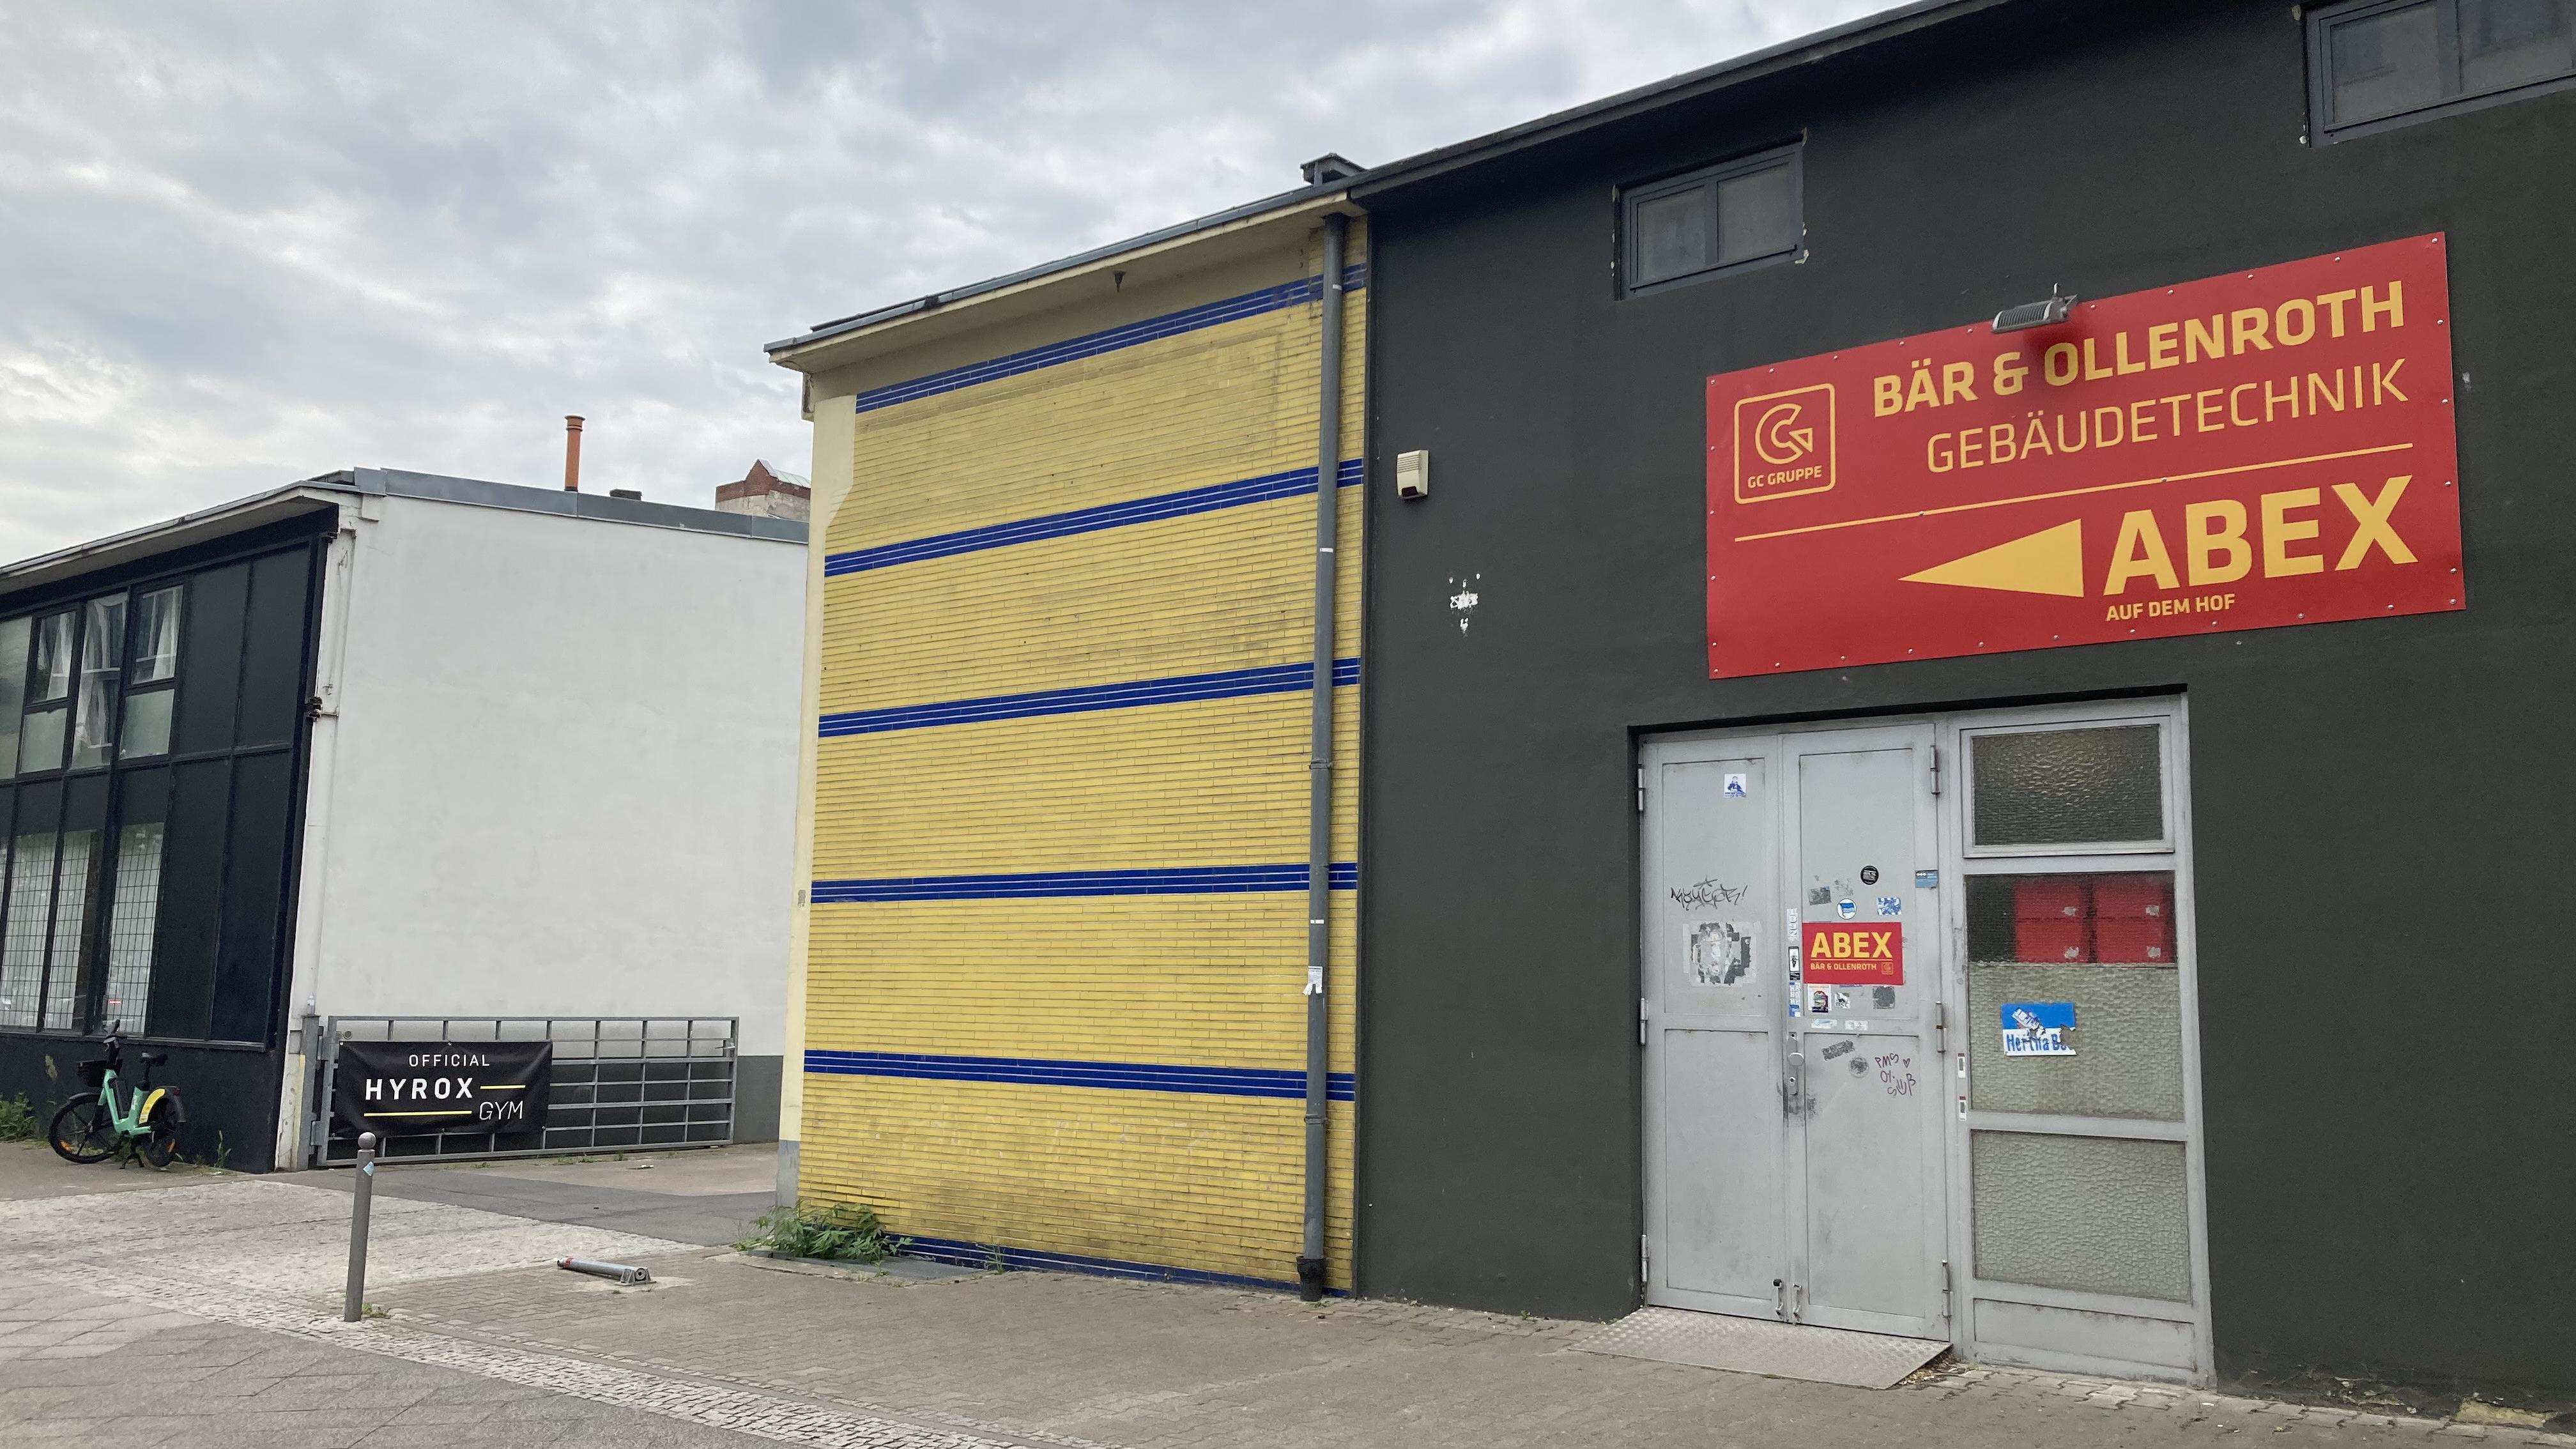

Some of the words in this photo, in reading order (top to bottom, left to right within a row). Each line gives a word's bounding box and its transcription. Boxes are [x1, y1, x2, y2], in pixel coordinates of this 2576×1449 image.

[1873, 359, 1977, 417] BÄR
[1993, 351, 2028, 396] &
[2044, 280, 2404, 386] OLLENROTH
[1927, 358, 2409, 473] GEBÄUDETECHNIK
[1747, 474, 1765, 489] GC
[1767, 464, 1822, 486] GRUPPE
[2103, 475, 2418, 596] ABEX
[2105, 603, 2143, 621] AUF
[2148, 598, 2190, 617] DEM
[2195, 593, 2235, 613] HOF
[1811, 931, 1892, 958] ABEX
[1810, 962, 1825, 970] BÄR
[409, 1054, 490, 1067] OFFICIAL
[365, 1077, 473, 1100] HYROX
[479, 1100, 524, 1121] GYM
